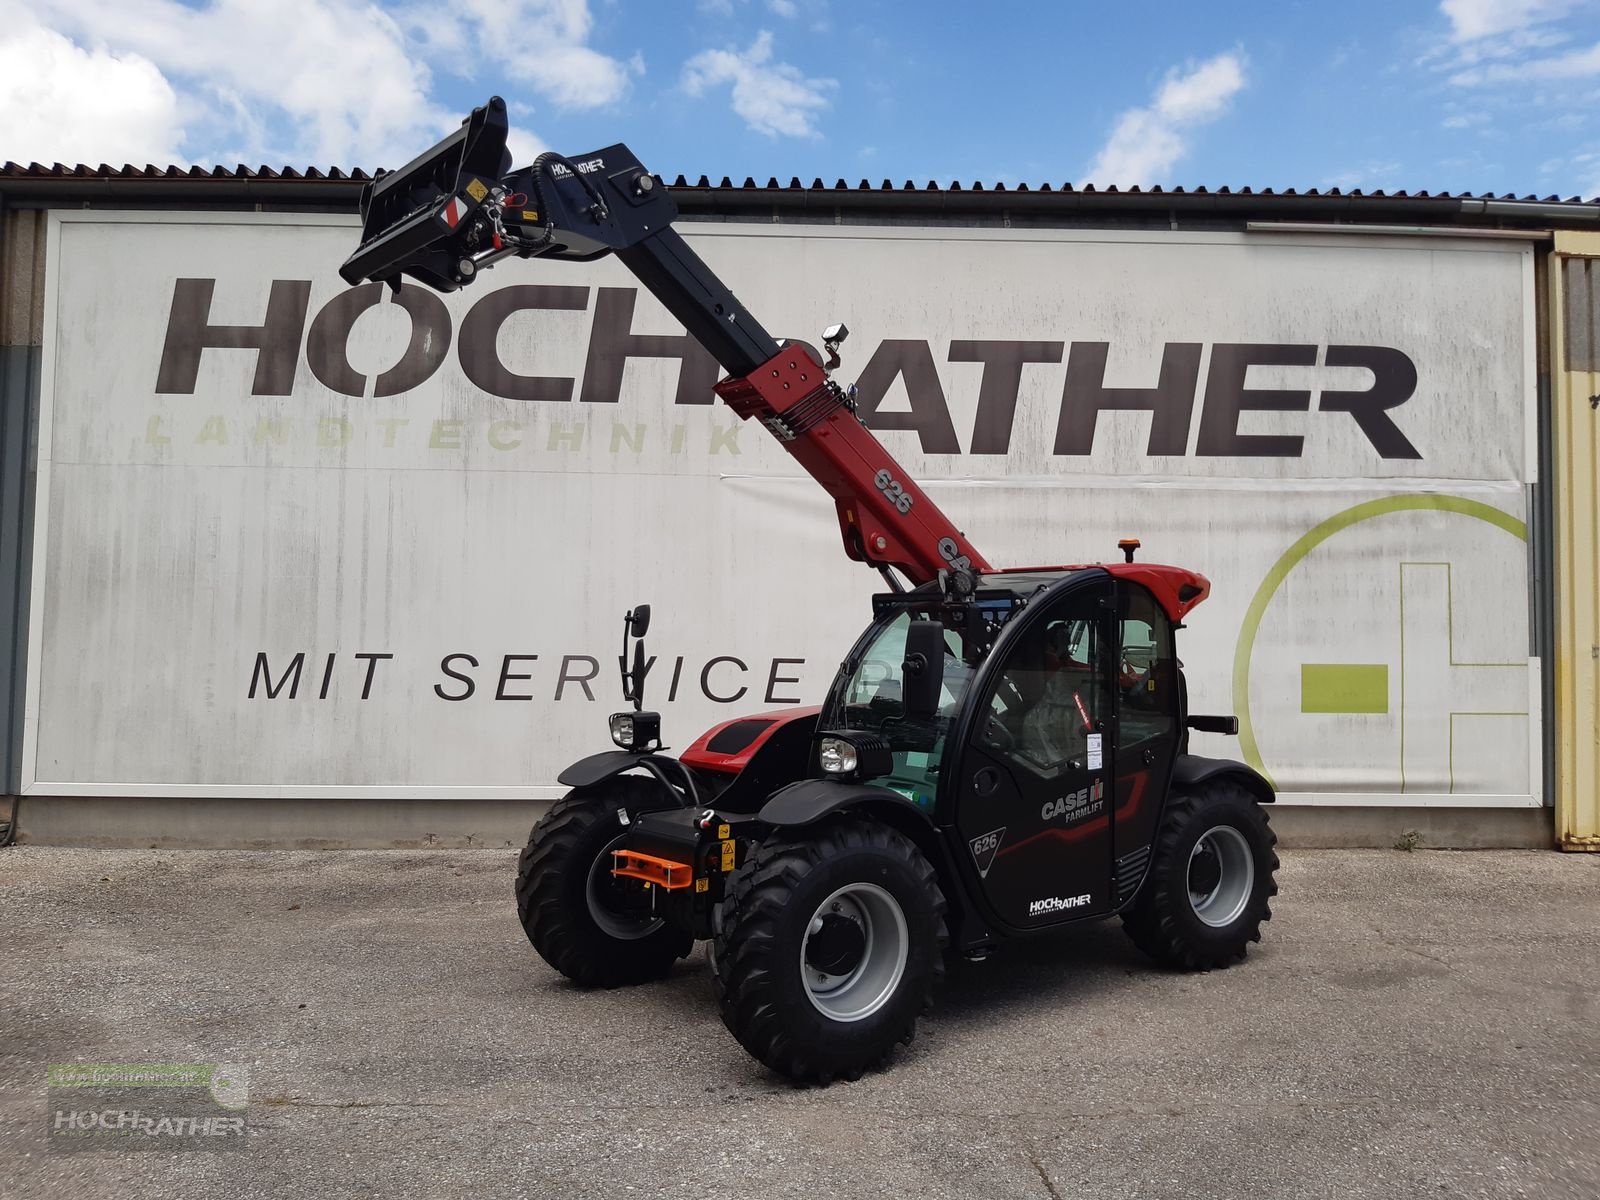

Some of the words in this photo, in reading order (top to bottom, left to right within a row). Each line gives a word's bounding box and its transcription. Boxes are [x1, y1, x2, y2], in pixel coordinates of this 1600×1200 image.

[155, 277, 1424, 460] HOCHATHER
[145, 413, 743, 455] LANDTECHNIK
[873, 468, 914, 514] 626
[247, 652, 394, 700] MIT
[1041, 787, 1088, 820] CASE
[1065, 801, 1104, 823] FARMLIFT
[973, 833, 997, 855] 626
[1029, 893, 1091, 913] HOCHRATHER
